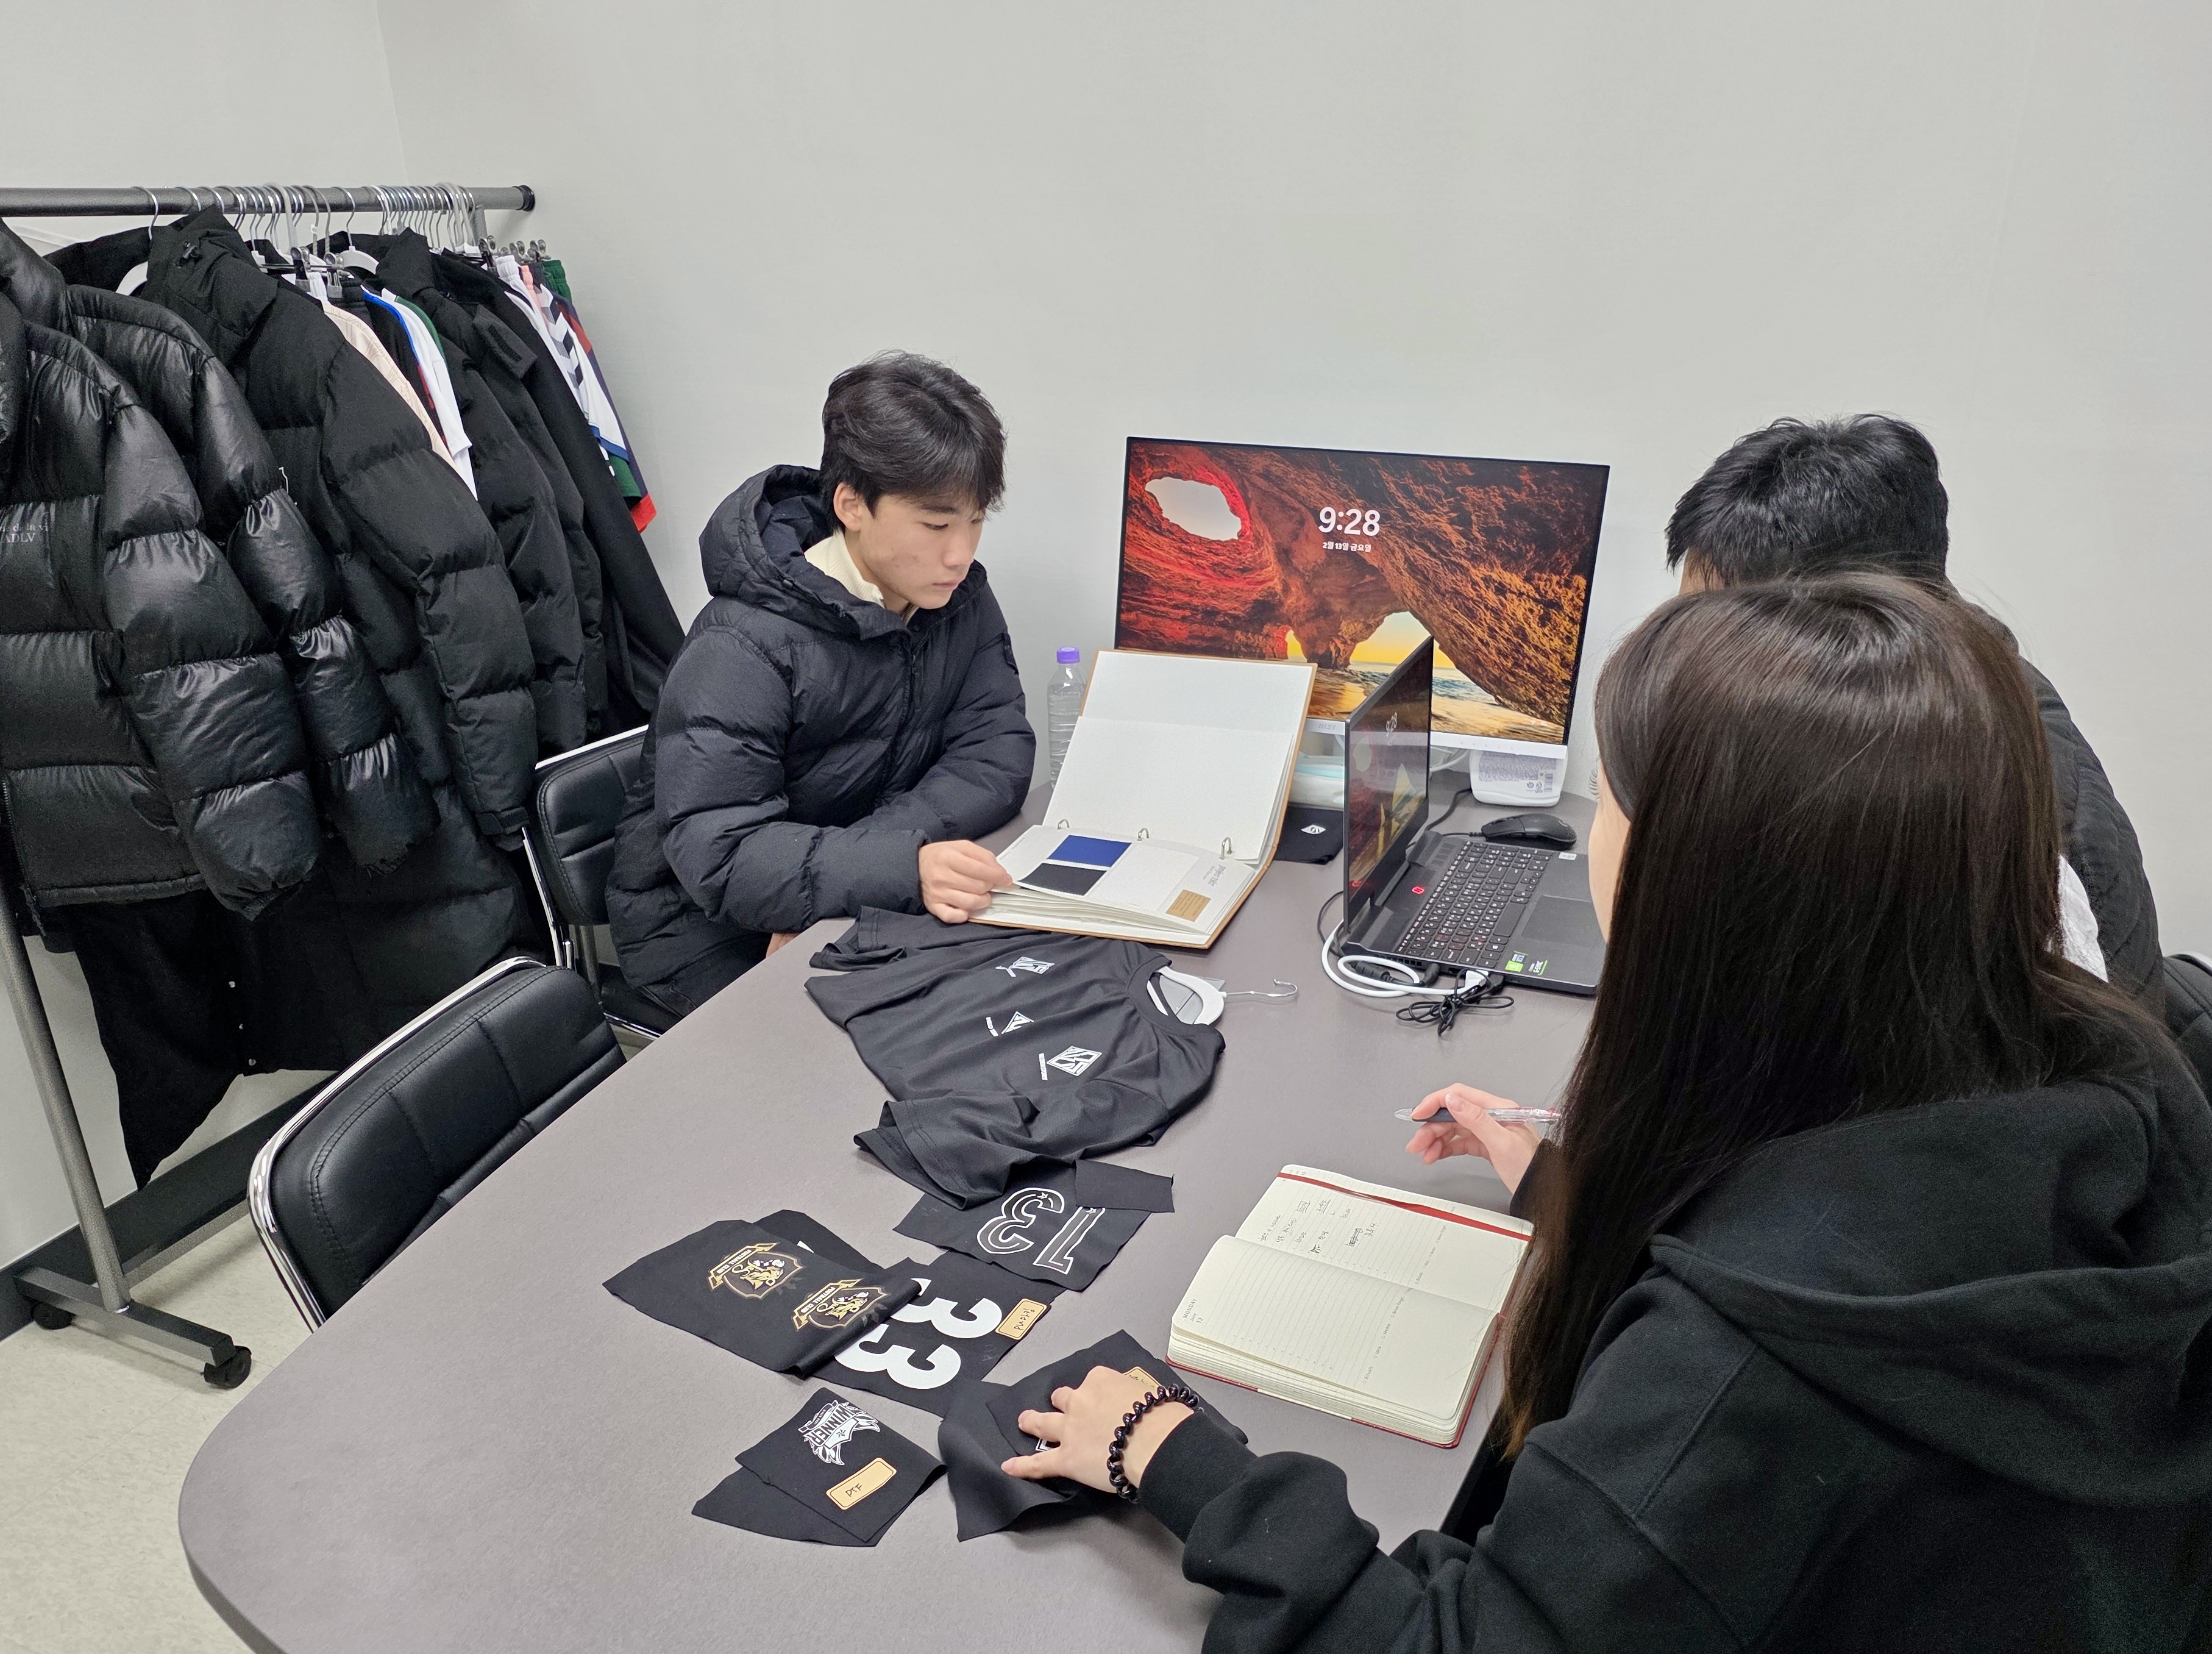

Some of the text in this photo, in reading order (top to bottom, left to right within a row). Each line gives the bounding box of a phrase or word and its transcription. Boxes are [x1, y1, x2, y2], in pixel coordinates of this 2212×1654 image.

[1318, 507, 1381, 536] 9:28
[977, 1187, 1106, 1275] 13
[728, 1249, 752, 1265] FOOTBALL
[1182, 1298, 1197, 1319] MONDAY
[806, 1405, 854, 1445] WINNER
[845, 1483, 862, 1497] DTF
